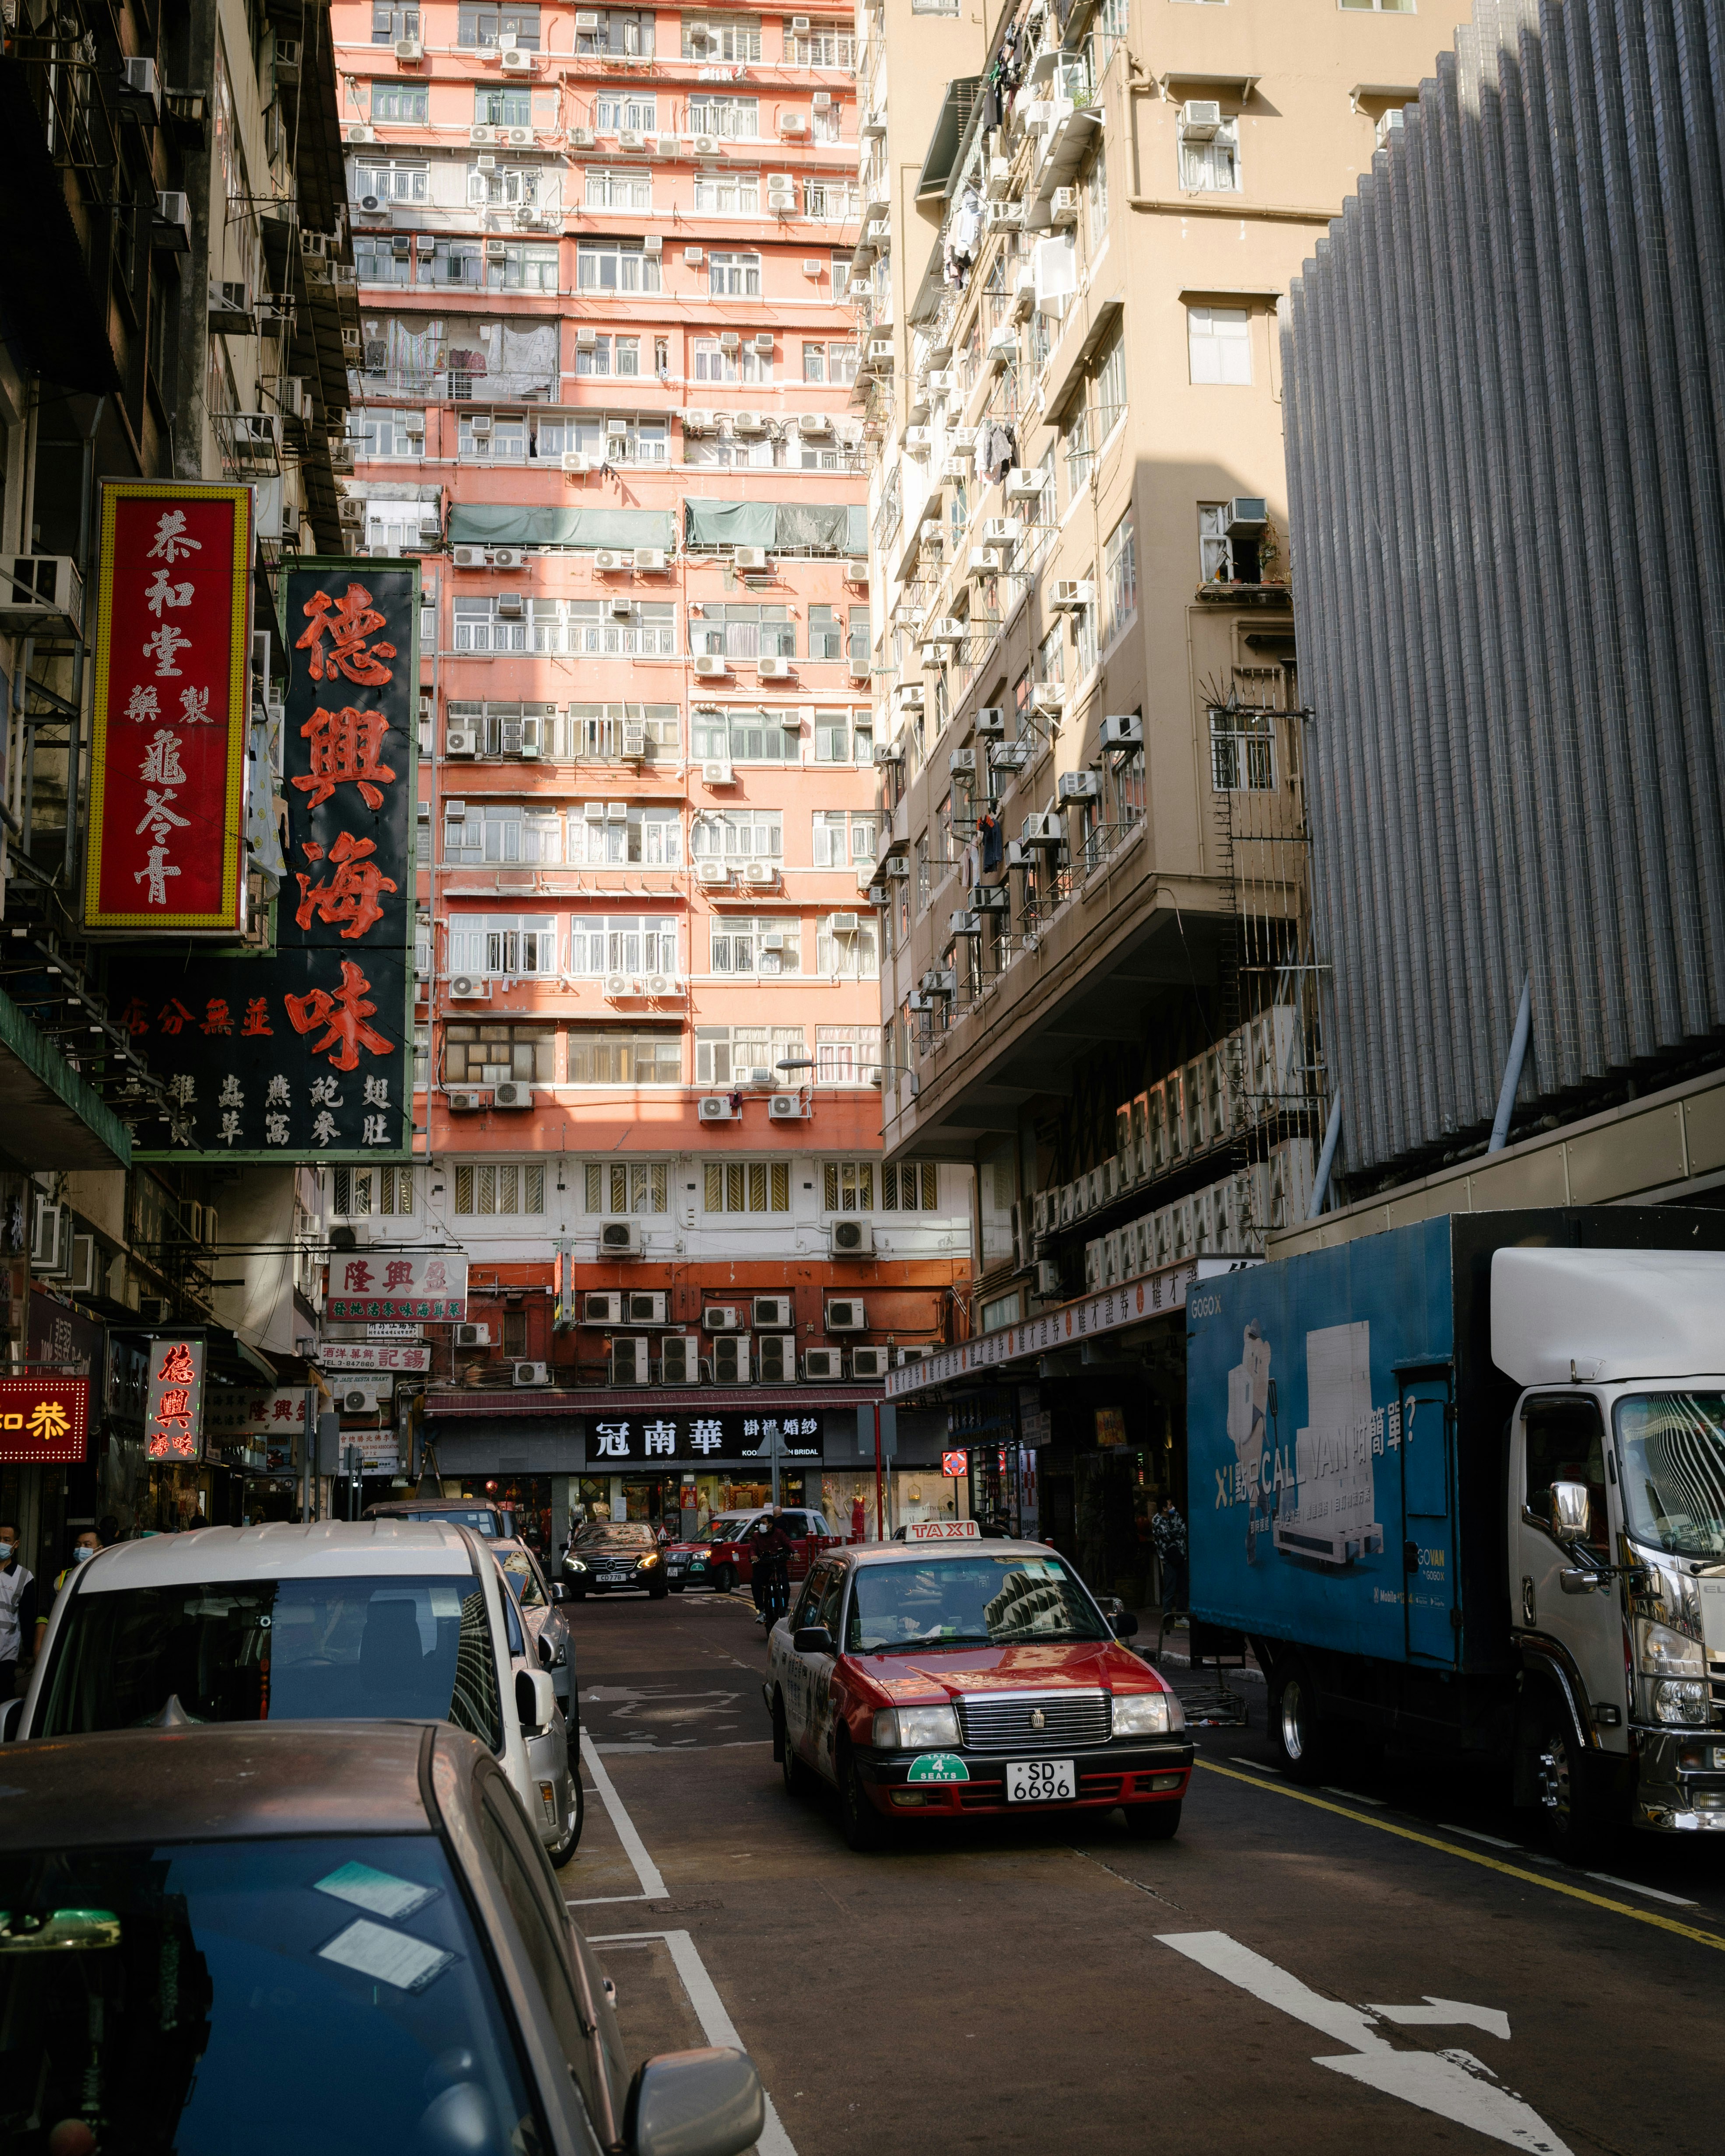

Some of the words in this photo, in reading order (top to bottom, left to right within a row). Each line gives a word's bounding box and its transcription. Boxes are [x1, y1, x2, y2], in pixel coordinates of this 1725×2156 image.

[596, 1420, 723, 1456] 冠南華
[912, 1522, 975, 1538] TAXI
[1380, 1589, 1397, 1603] Mobile
[932, 1759, 944, 1772] 4
[1028, 1763, 1055, 1781] SD
[1014, 1780, 1069, 1800] 6696
